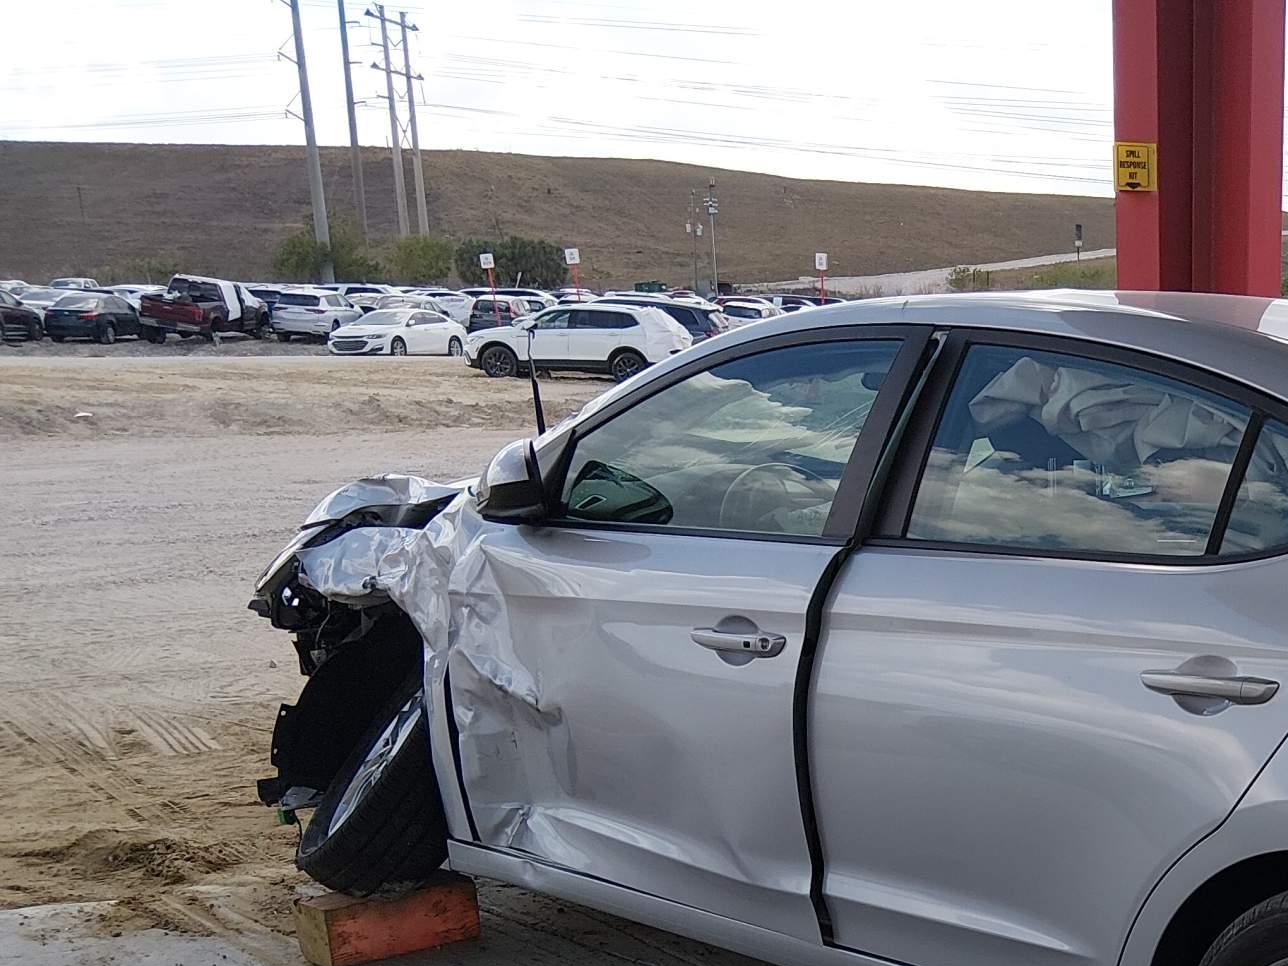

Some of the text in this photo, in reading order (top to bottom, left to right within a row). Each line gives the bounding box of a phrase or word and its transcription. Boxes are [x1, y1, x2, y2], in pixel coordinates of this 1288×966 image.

[1126, 149, 1141, 159] SPILL
[1120, 160, 1148, 170] RESPONSE
[1128, 171, 1139, 180] KIT
